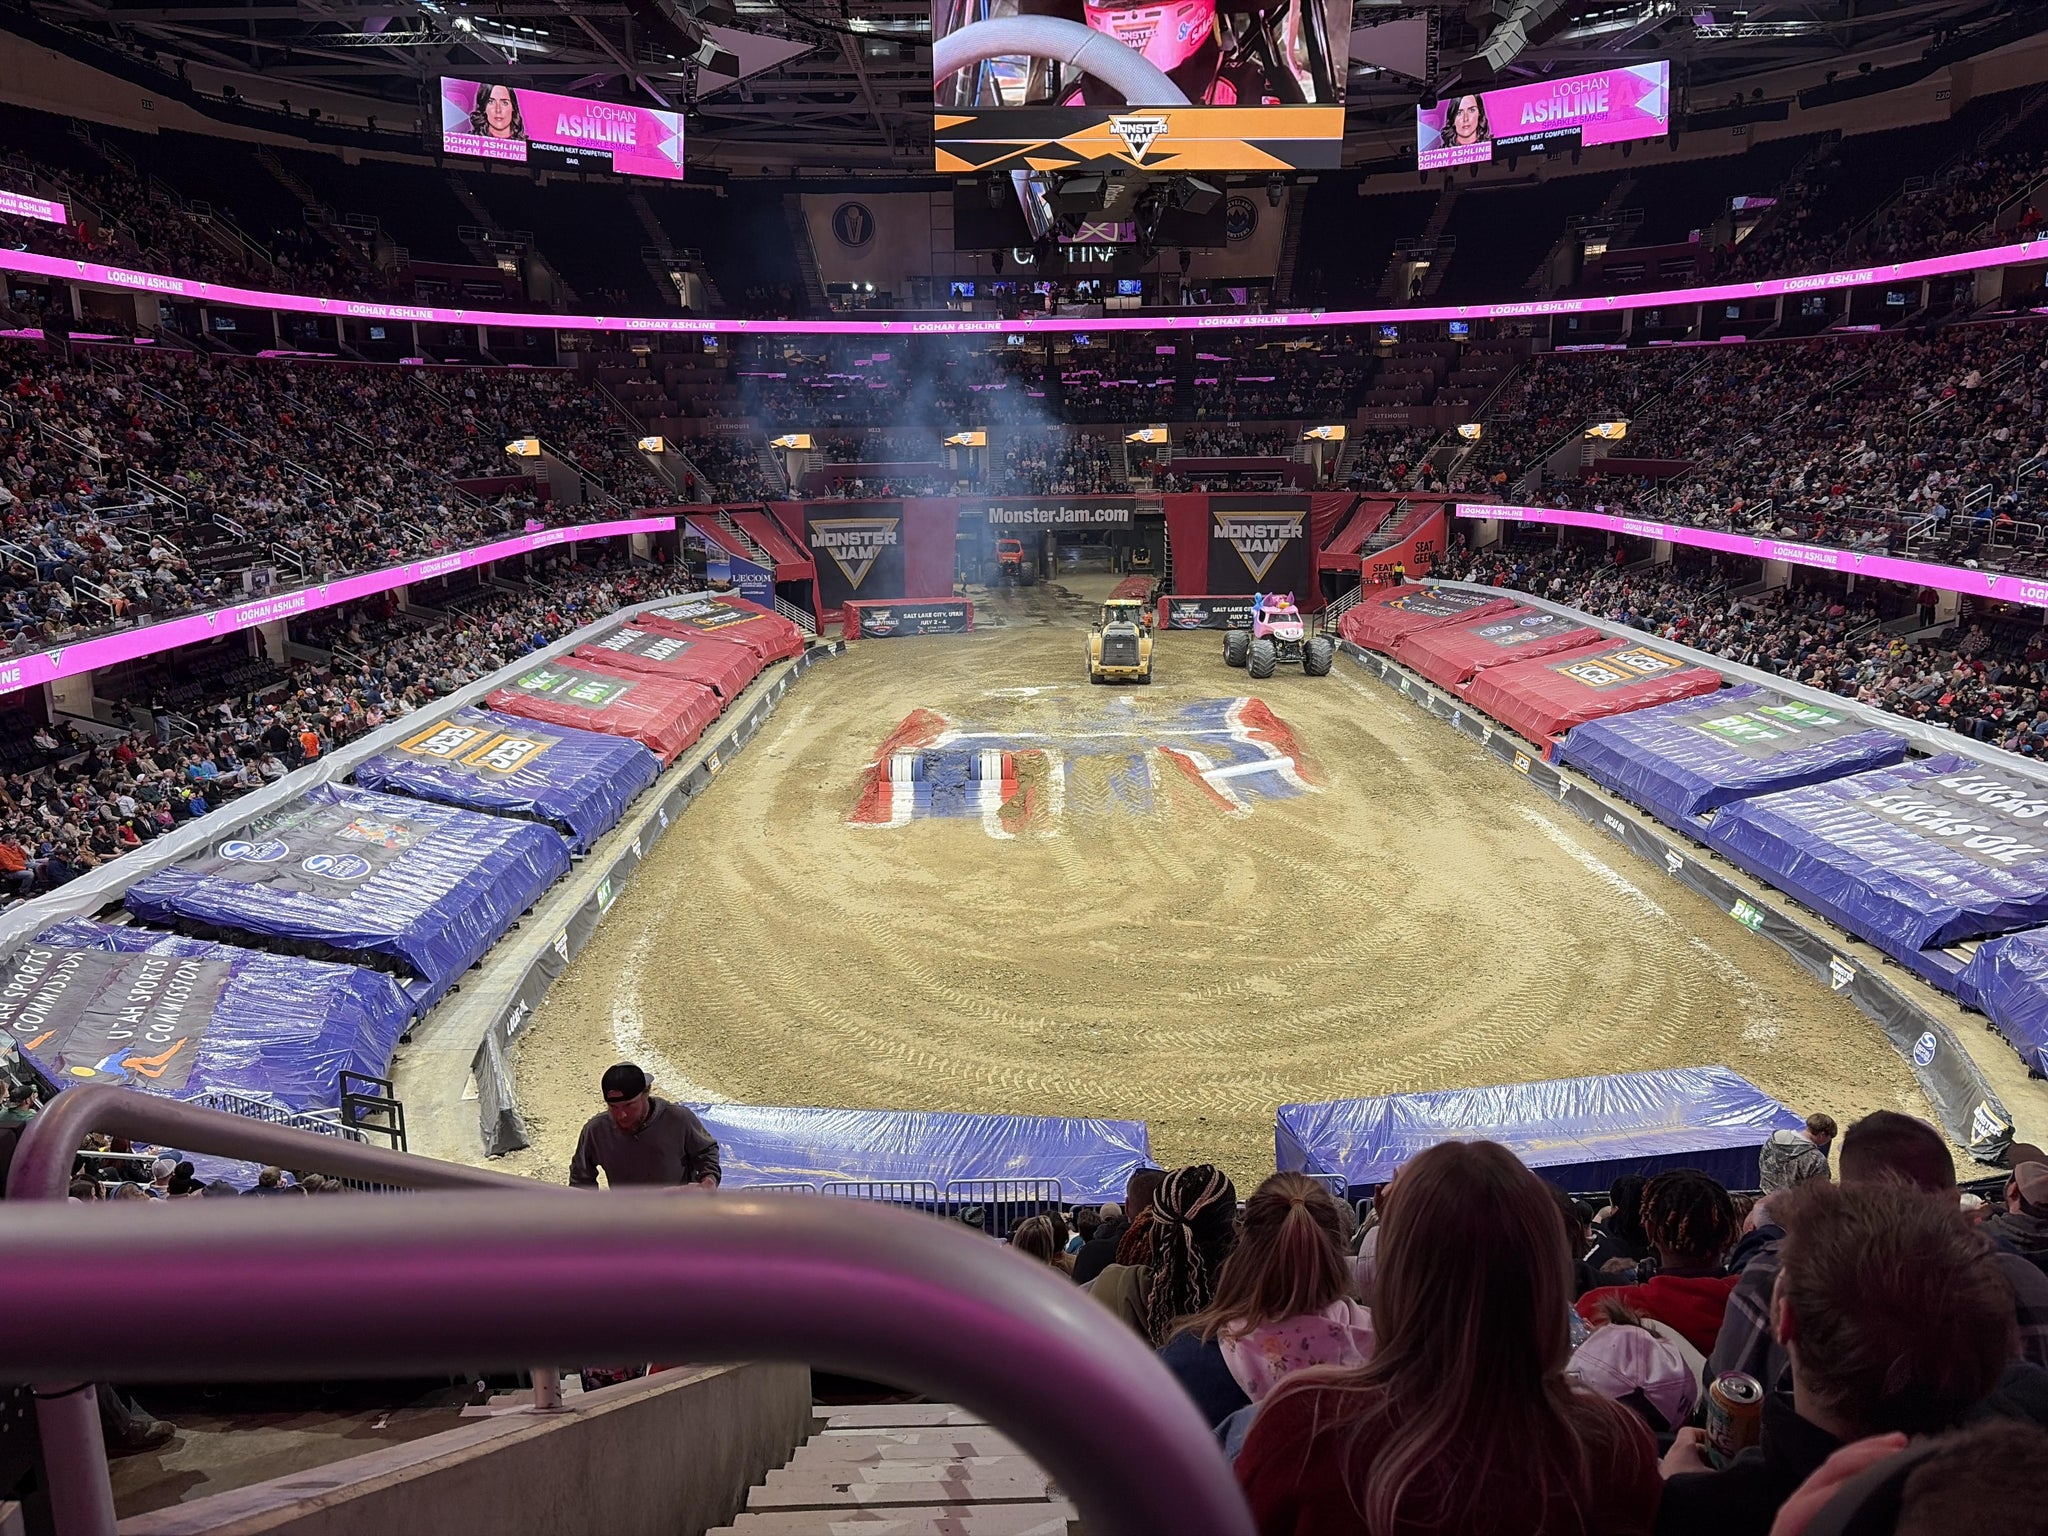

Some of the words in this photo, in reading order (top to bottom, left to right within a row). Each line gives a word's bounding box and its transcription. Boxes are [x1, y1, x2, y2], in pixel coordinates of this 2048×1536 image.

[1553, 76, 1609, 97] LOGHAN
[586, 105, 636, 123] LOGHAN
[1521, 90, 1609, 124] ASHLINE
[556, 113, 636, 145] ASHLINE
[1110, 123, 1168, 134] MONSTER
[1542, 118, 1578, 130] SPARKLE
[1579, 113, 1608, 124] SMASH
[576, 138, 609, 149] SPARKLE
[611, 142, 636, 152] SMASH
[1124, 133, 1153, 144] JAM
[1497, 135, 1529, 146] CANCEROUR
[1529, 132, 1544, 140] NEXT
[1545, 127, 1581, 138] COMPETITOR
[482, 141, 525, 152] ASHLINE
[532, 142, 565, 153] CANCEROUR
[565, 147, 578, 155] NEXT
[579, 149, 612, 158] COMPETITOR
[1451, 146, 1491, 157] ASHLINE
[18, 200, 51, 215] ASHLINE
[107, 271, 146, 287] LOGHAN
[147, 277, 185, 292] ASHLINE
[1783, 278, 1825, 290] LOGHAN
[1827, 271, 1874, 285] ASHLINE
[347, 304, 387, 316] LOGHAN
[389, 308, 433, 319] ASHLINE
[1490, 305, 1533, 315] LOGHAN
[1536, 302, 1582, 313] ASHLINE
[625, 321, 669, 329] LOGHAN
[671, 321, 716, 330] ASHLINE
[912, 323, 956, 331] LOGHAN
[957, 322, 1002, 331] ASHLINE
[1198, 317, 1241, 326] LOGHAN
[1243, 316, 1289, 325] ASHLINE
[988, 506, 1129, 524] MonsterJam.com
[1492, 507, 1523, 517] ASHLINE
[811, 531, 897, 547] MONSTER
[1213, 524, 1303, 539] MONSTER
[834, 546, 875, 560] JAM
[1238, 538, 1280, 553] JAM
[1415, 540, 1434, 553] SEAT
[1774, 547, 1803, 559] LOGHAN
[1804, 551, 1837, 564] ASHLINE
[1373, 562, 1394, 572] SEAT
[236, 605, 271, 623] LOGHAN
[272, 596, 305, 613] ASHLINE
[1616, 653, 1670, 671] JCB
[521, 671, 560, 690] BKT
[1568, 665, 1620, 684] JCB
[574, 681, 610, 702] BKT
[1775, 704, 1841, 725] BKT
[1710, 716, 1779, 739] BKT
[415, 726, 477, 754] JCB
[478, 741, 535, 769] JCB
[1937, 776, 2048, 818] LUCAS
[1603, 813, 1619, 829] LUCAS
[1616, 822, 1625, 835] OIL
[1864, 795, 1991, 836] LUCAS
[1731, 901, 1765, 927] BKT
[4, 949, 53, 998] SPORTS
[127, 959, 169, 1002] SPORTS
[144, 959, 201, 1043] COMMISSION
